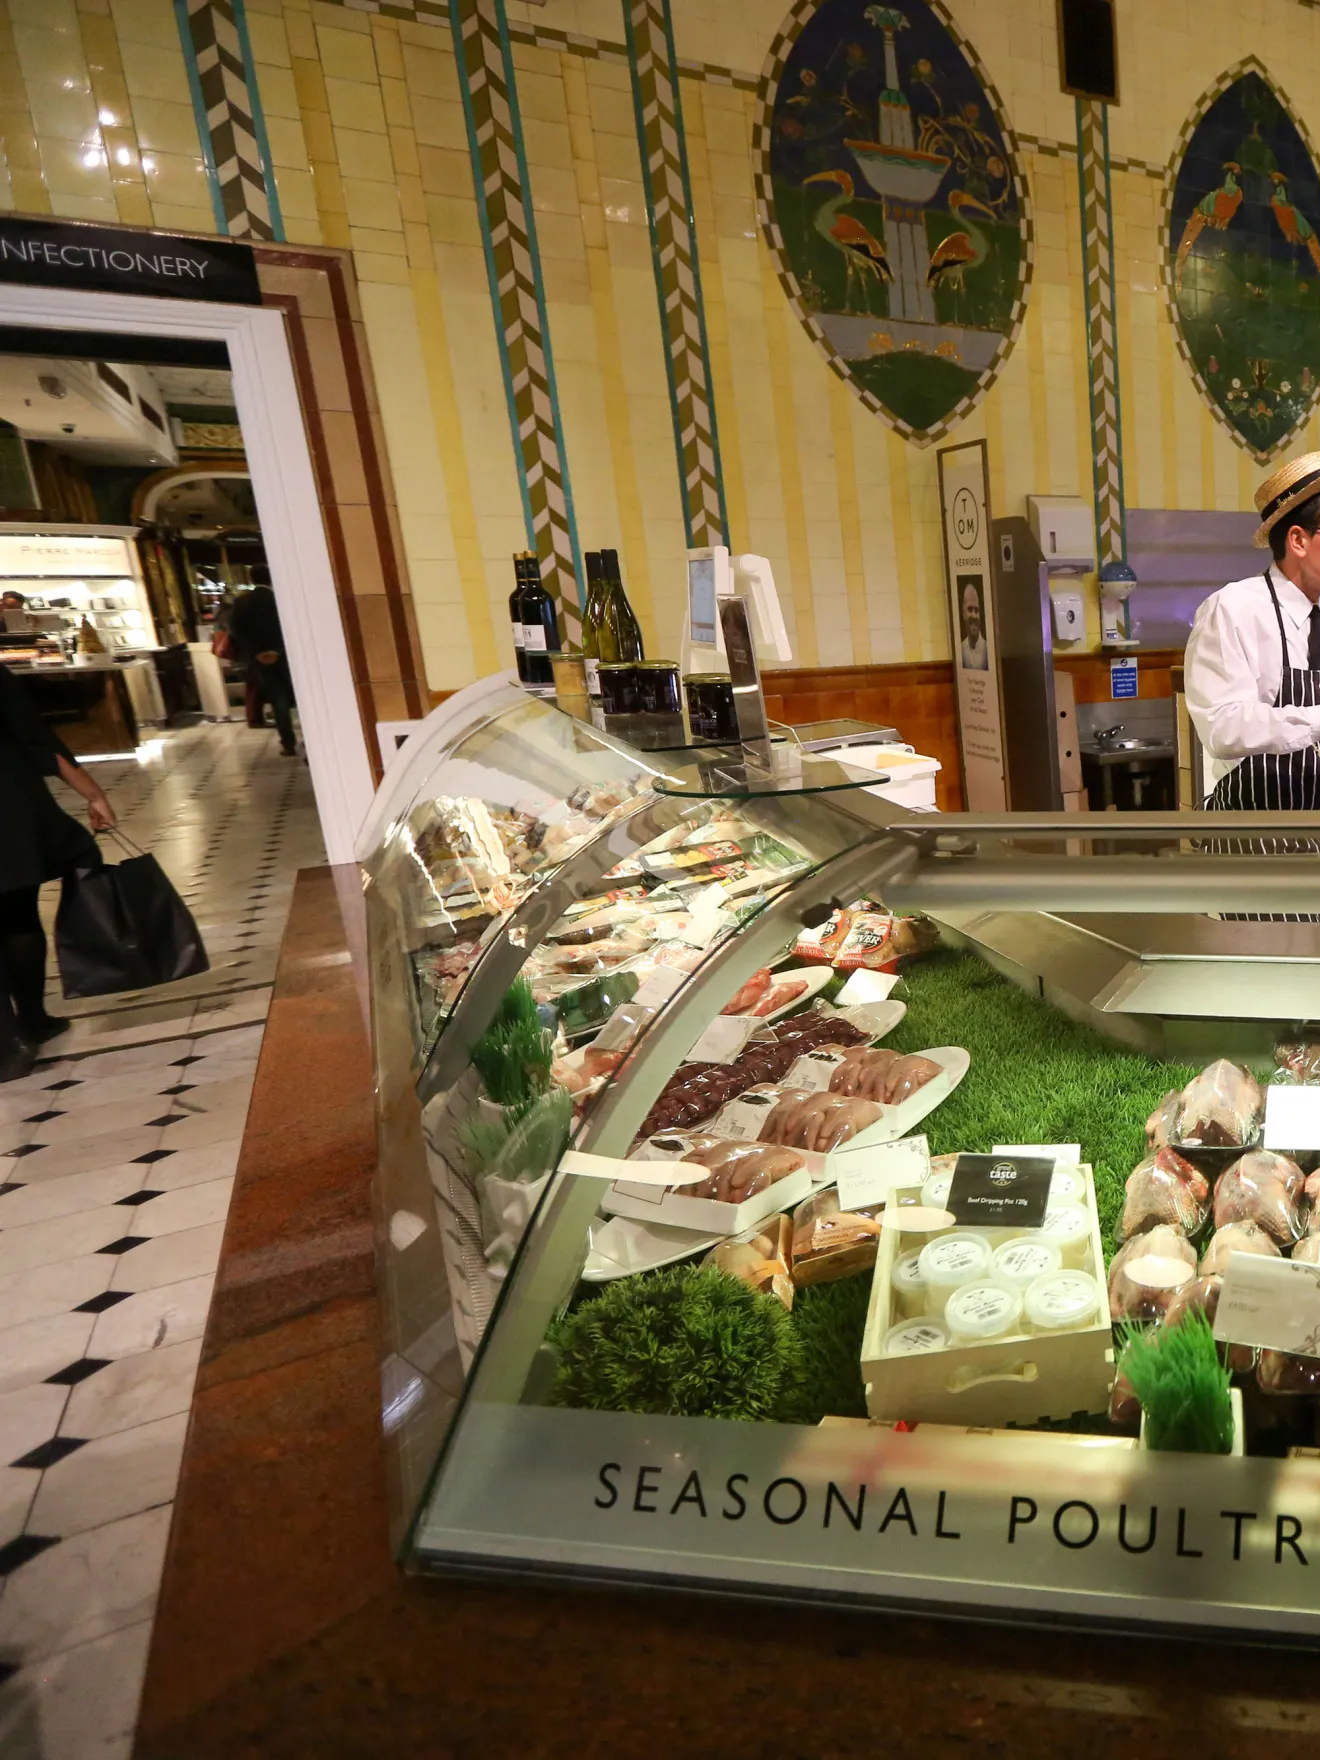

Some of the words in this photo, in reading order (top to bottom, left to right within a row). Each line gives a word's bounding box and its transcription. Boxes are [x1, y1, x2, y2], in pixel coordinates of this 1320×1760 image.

[955, 557, 983, 567] KERRIDGE
[990, 1170, 1017, 1179] taste
[980, 1198, 1004, 1206] Dripping
[594, 1462, 961, 1540] SEASONAL
